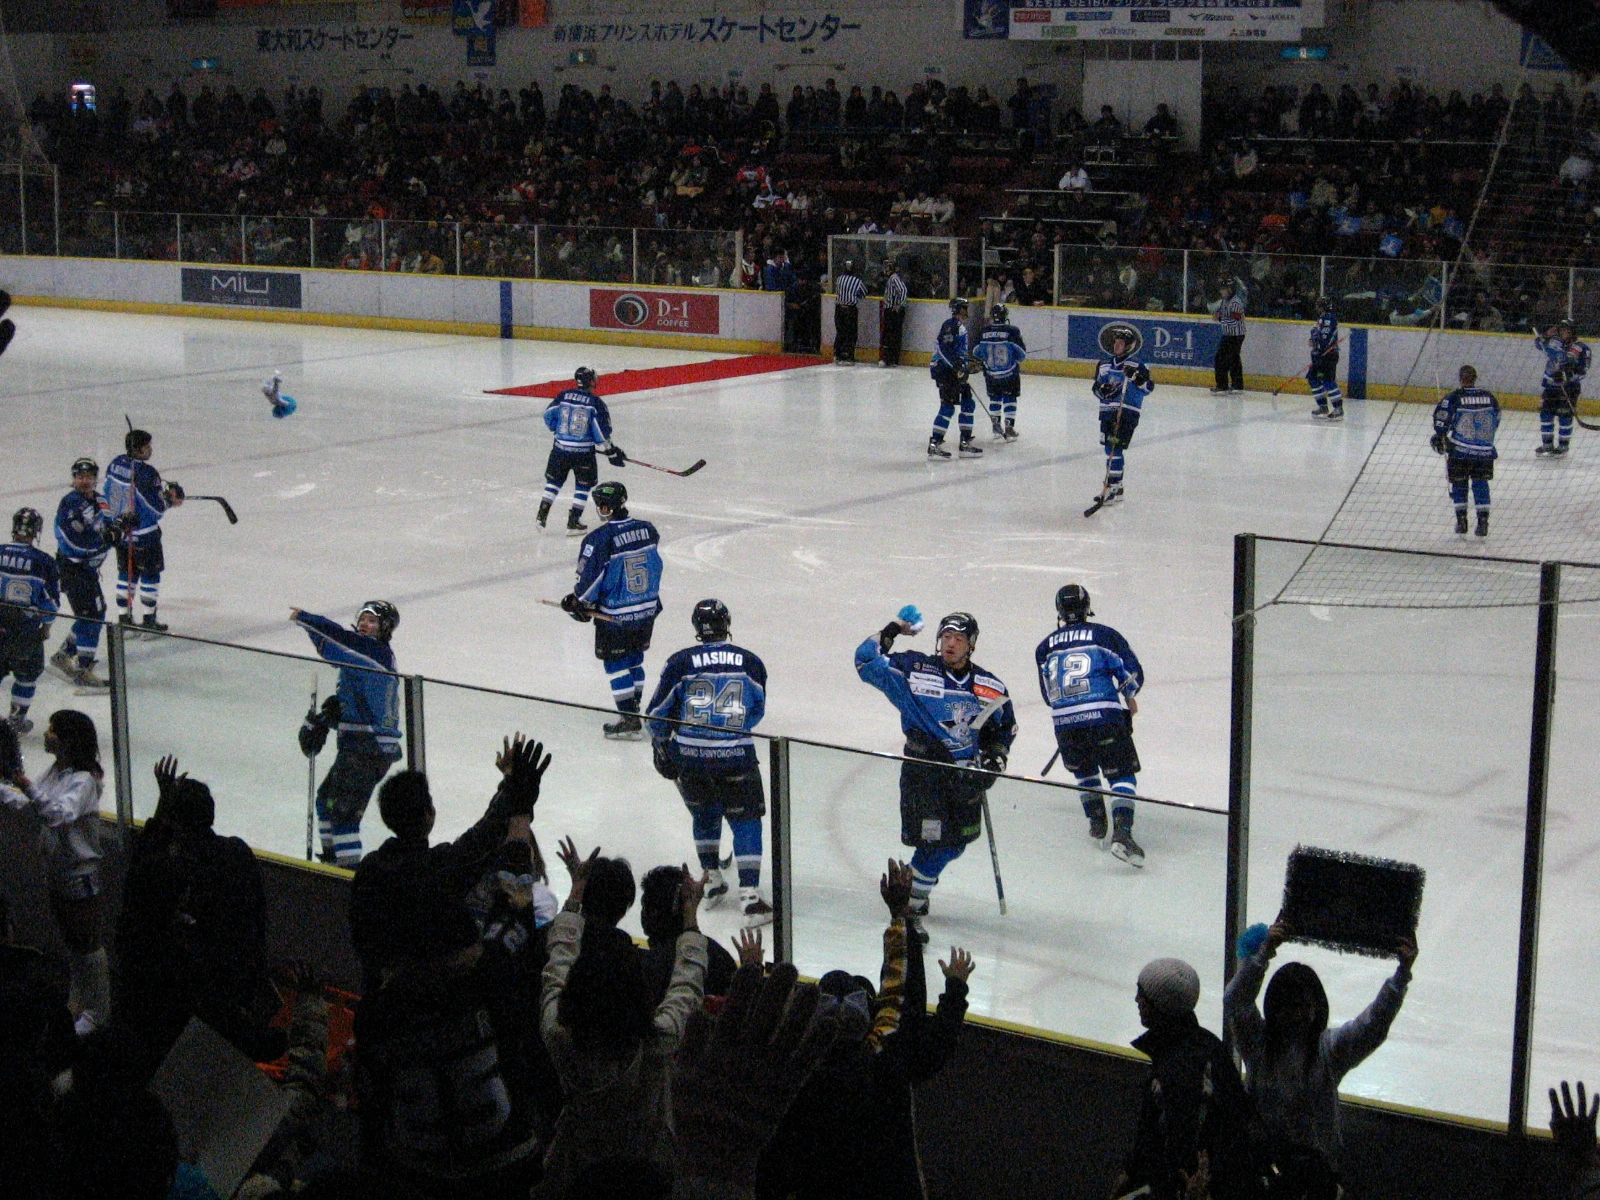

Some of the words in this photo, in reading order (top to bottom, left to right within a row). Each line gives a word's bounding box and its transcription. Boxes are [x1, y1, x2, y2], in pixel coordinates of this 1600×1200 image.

[657, 298, 689, 319] D-1
[657, 319, 689, 328] COFFEE
[1152, 326, 1194, 350] D-1
[1153, 350, 1195, 360] COFFEE
[564, 392, 590, 404] SUZUKI
[558, 406, 589, 437] 18
[623, 553, 649, 594] 5
[691, 651, 744, 668] MASUKO
[1046, 652, 1092, 702] 12
[684, 678, 747, 729] 24
